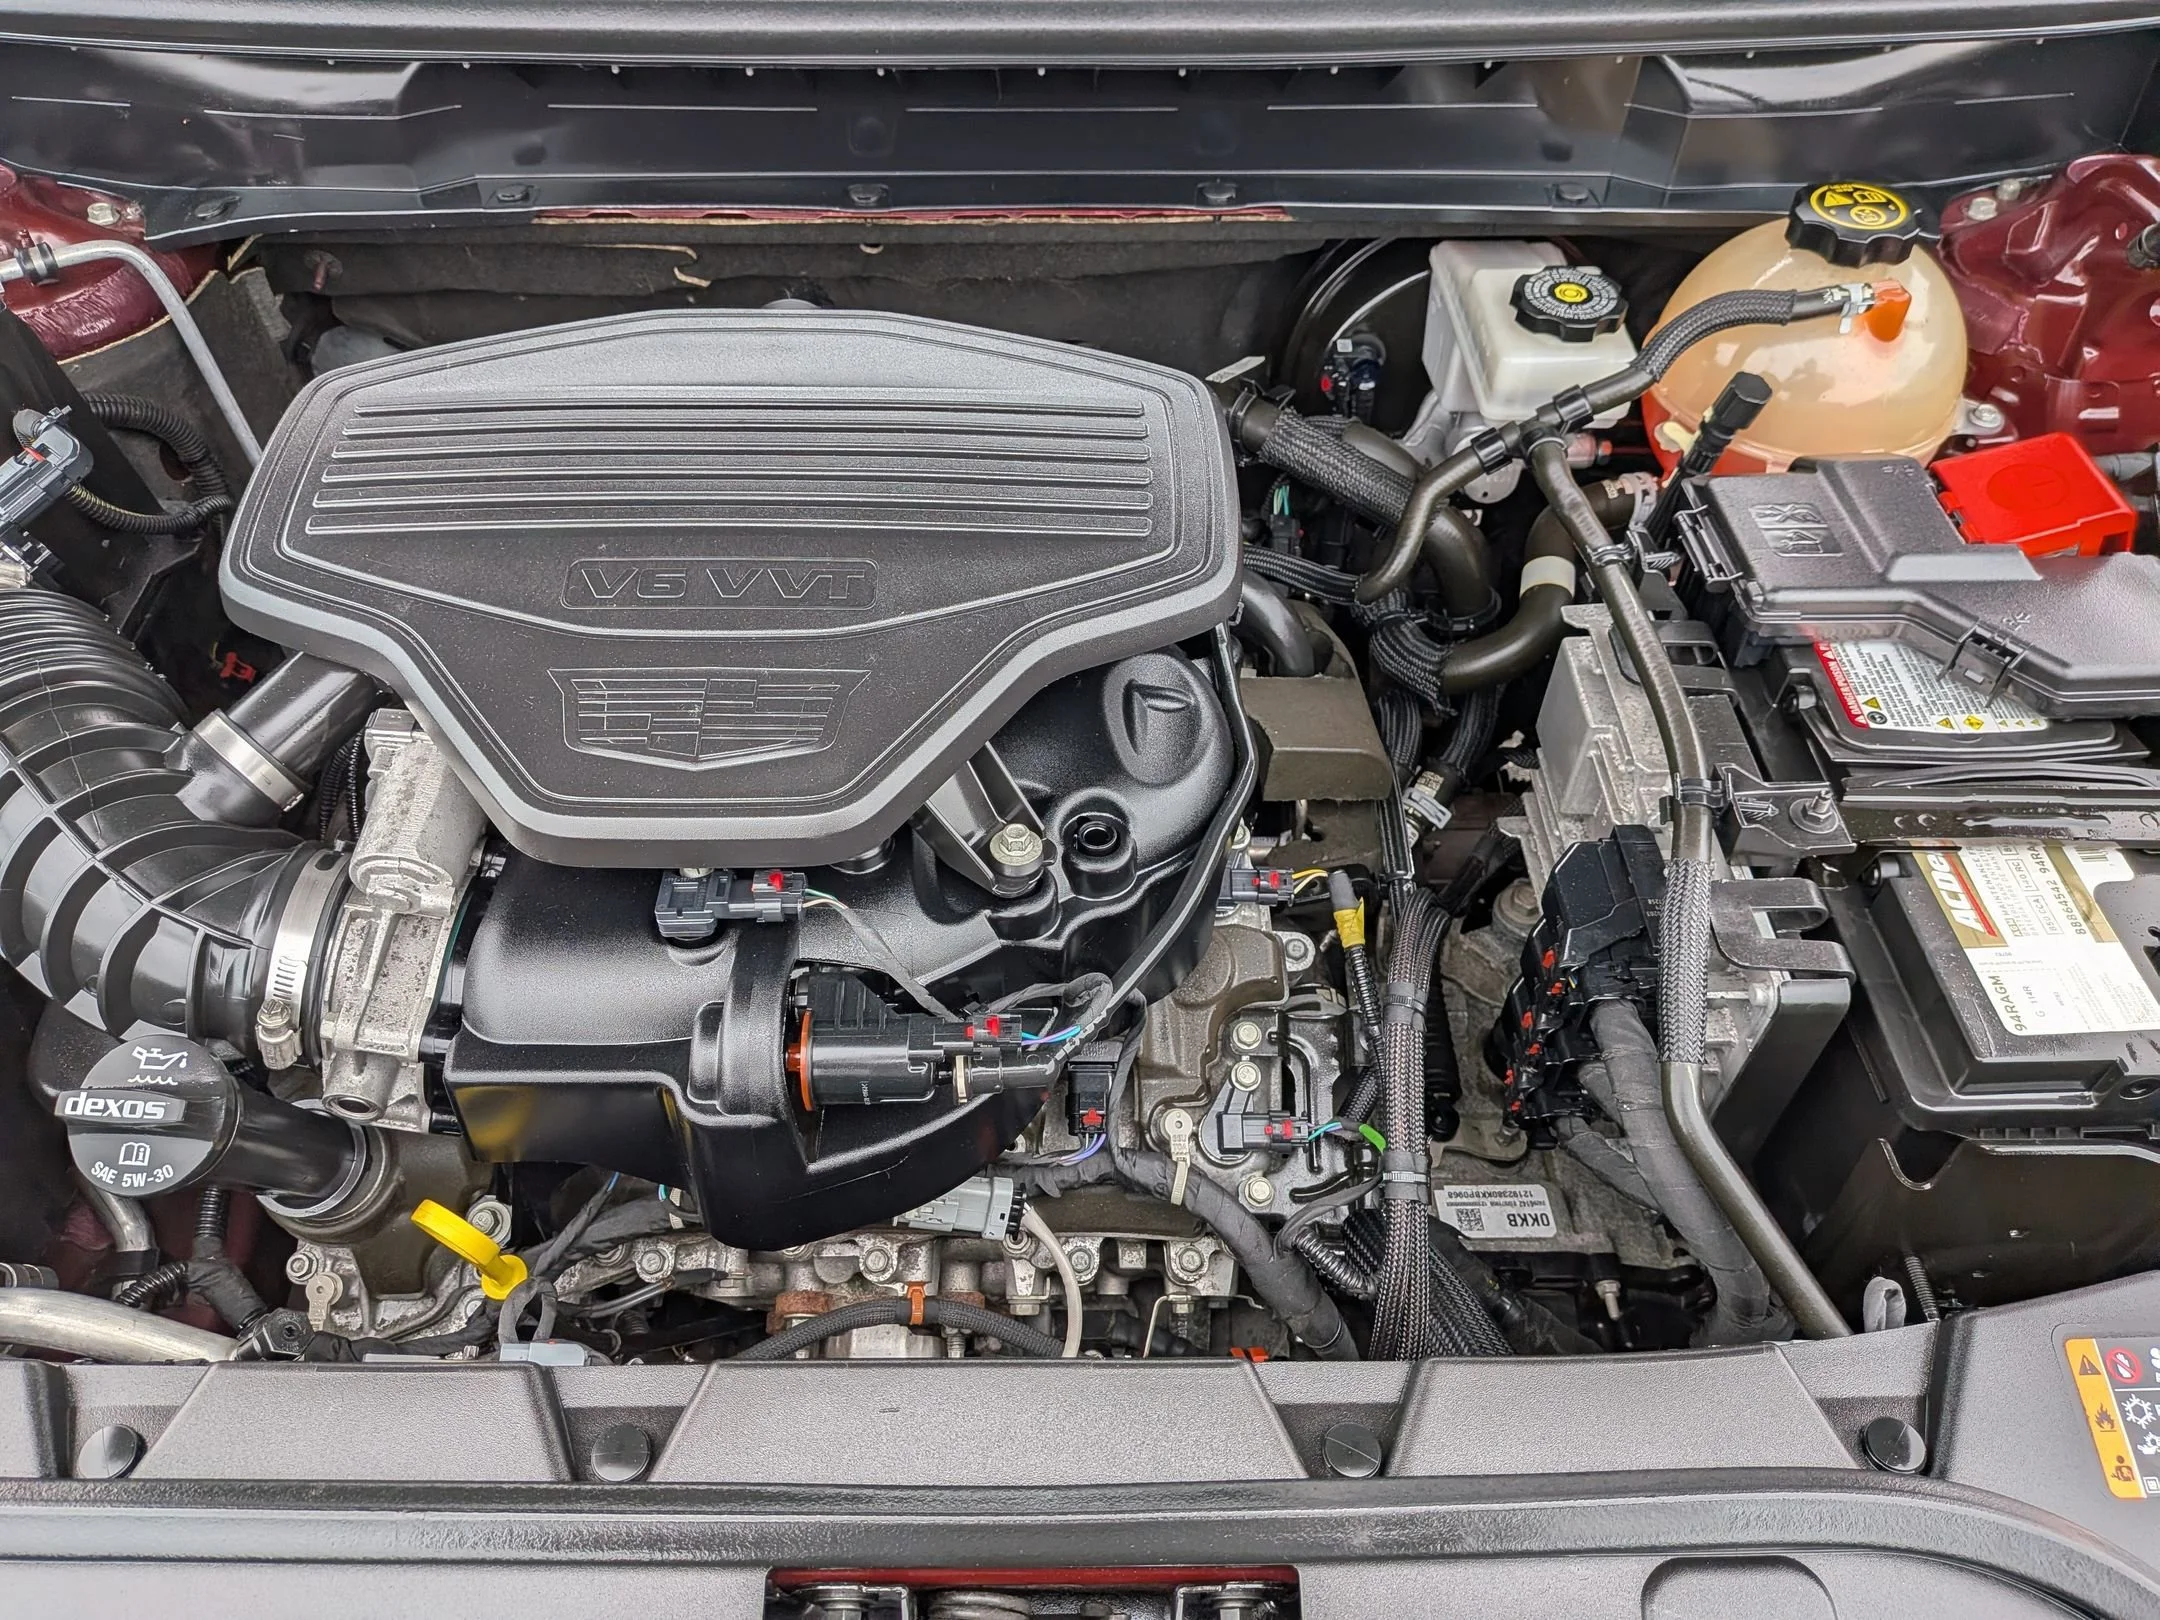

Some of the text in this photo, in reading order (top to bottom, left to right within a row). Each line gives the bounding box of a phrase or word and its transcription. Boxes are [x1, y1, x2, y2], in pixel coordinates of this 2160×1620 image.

[581, 567, 866, 599] V6 VVT
[1975, 847, 1999, 879] ENTRETIE
[1983, 847, 2002, 870] MANTE
[2011, 861, 2023, 871] RC
[1926, 853, 1985, 933] ACDe
[1972, 857, 2009, 915] MAINTENANCE
[2025, 845, 2087, 934] 88864542 94RA
[2032, 898, 2057, 930] 850 CCA
[1987, 975, 2028, 1031] 94RAGM
[65, 1092, 165, 1119] dexos
[91, 1161, 174, 1188] SAE 5W-30
